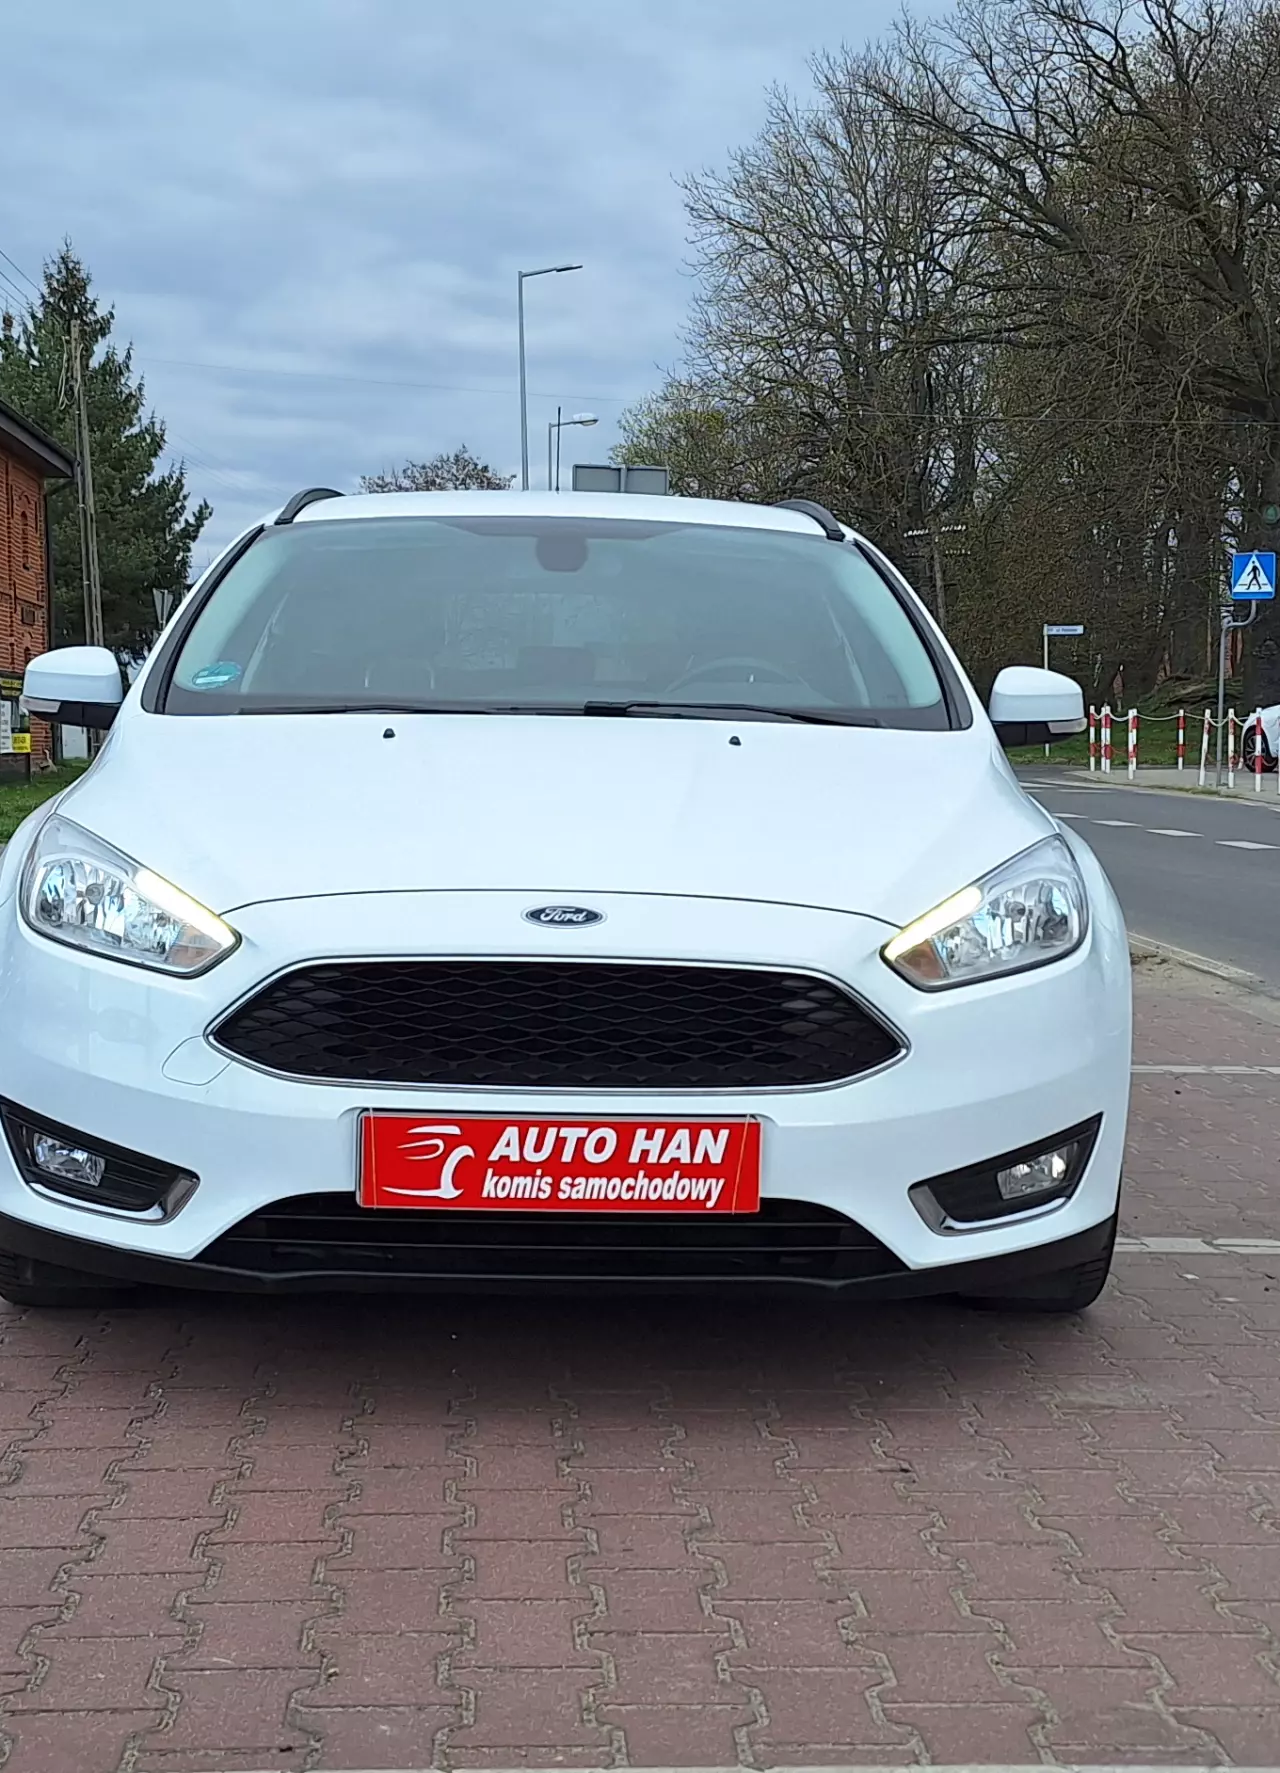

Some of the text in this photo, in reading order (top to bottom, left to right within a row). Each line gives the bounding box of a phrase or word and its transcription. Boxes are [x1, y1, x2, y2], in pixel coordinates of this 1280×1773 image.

[540, 908, 588, 922] Ford
[487, 1126, 730, 1164] AUTO HAN
[481, 1168, 725, 1208] komis samochodowy
